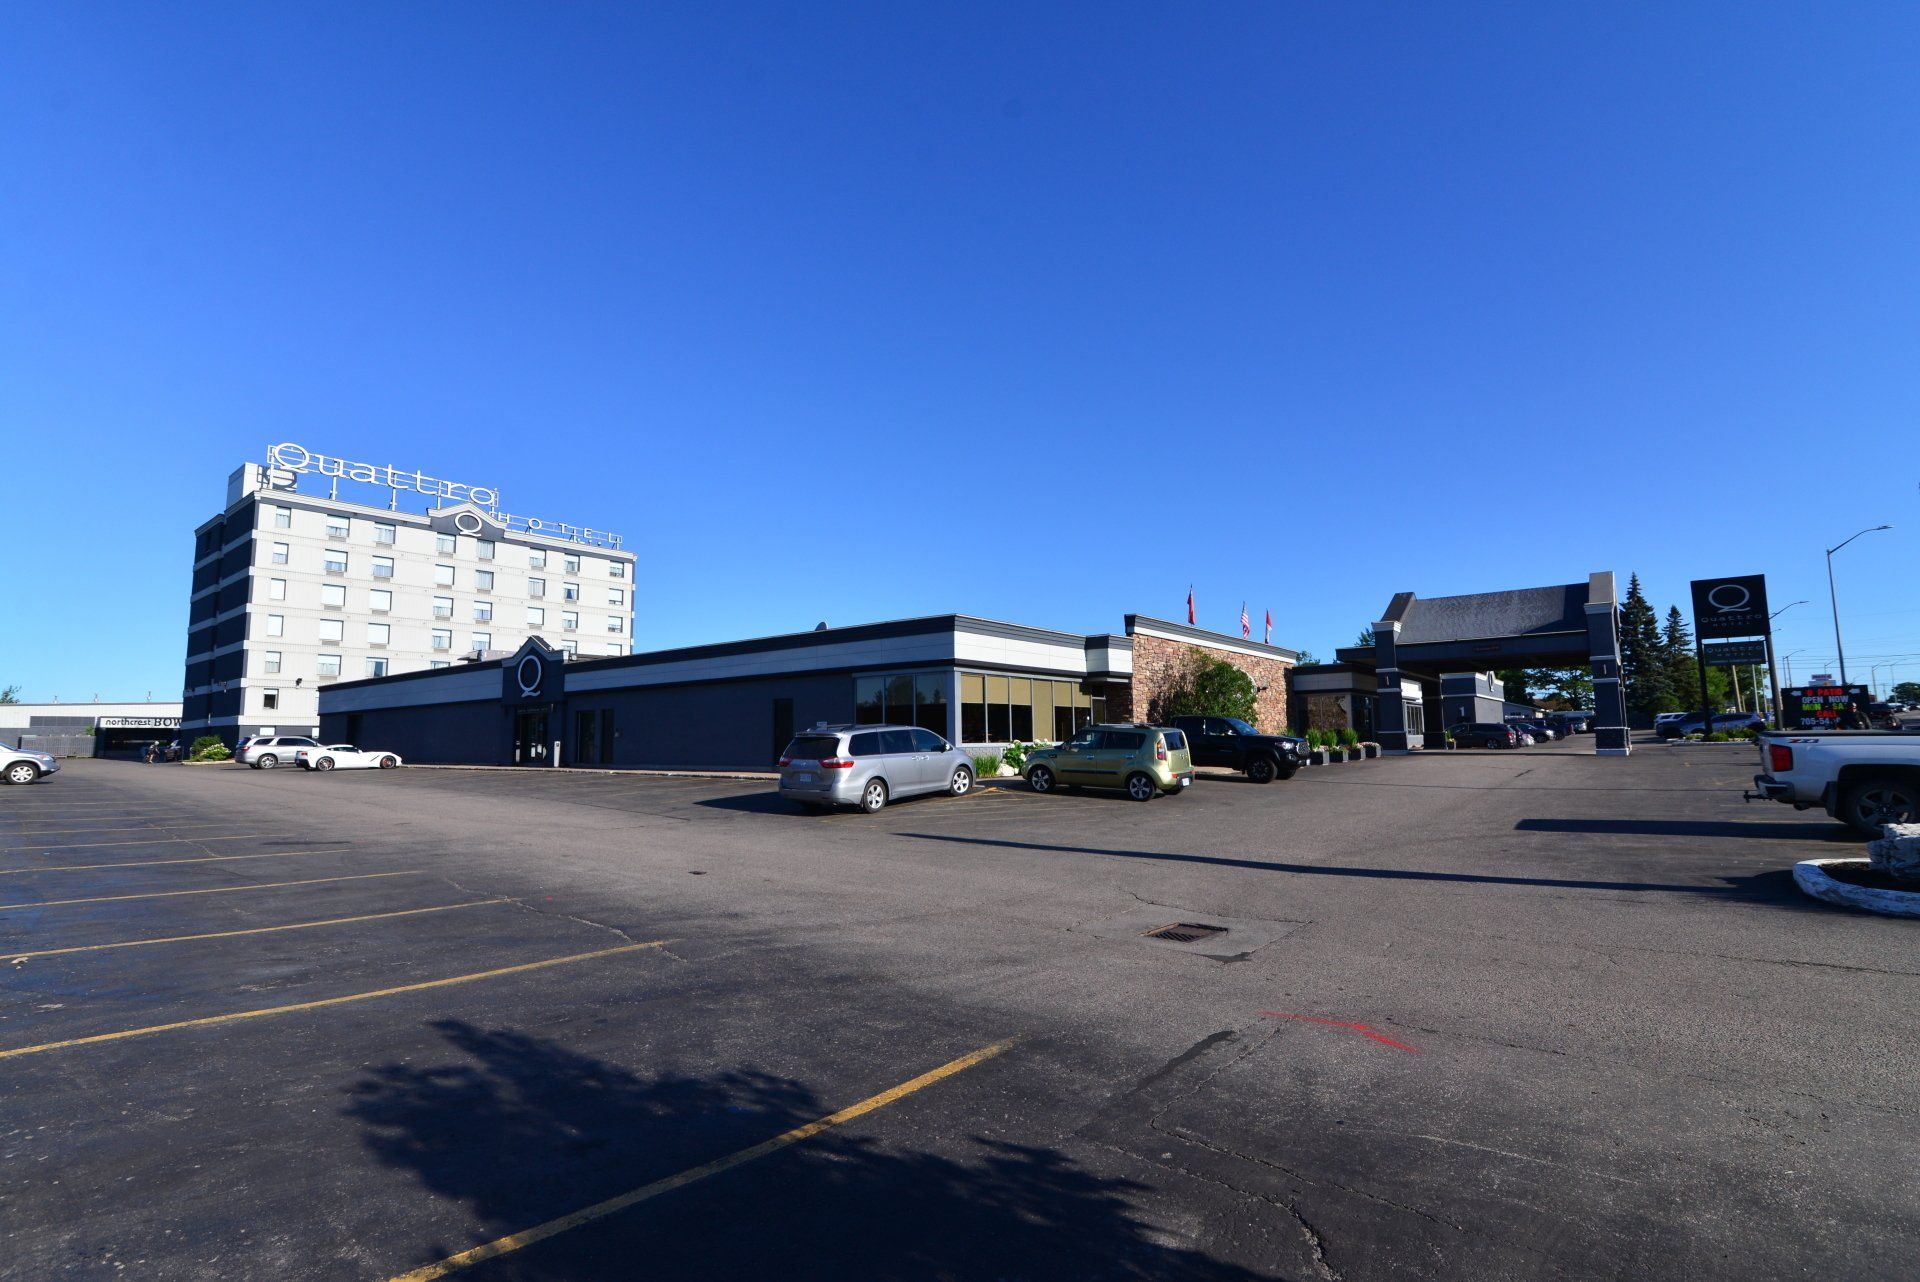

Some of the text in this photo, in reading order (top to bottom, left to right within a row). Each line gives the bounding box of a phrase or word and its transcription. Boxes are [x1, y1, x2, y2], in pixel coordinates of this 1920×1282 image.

[274, 443, 494, 505] Quattro
[454, 512, 482, 537] Q
[498, 513, 615, 543] HOTEL
[1708, 584, 1751, 613] Q
[518, 655, 542, 697] Q
[1802, 695, 1849, 704] OPEN NOW
[106, 718, 151, 726] northcrest
